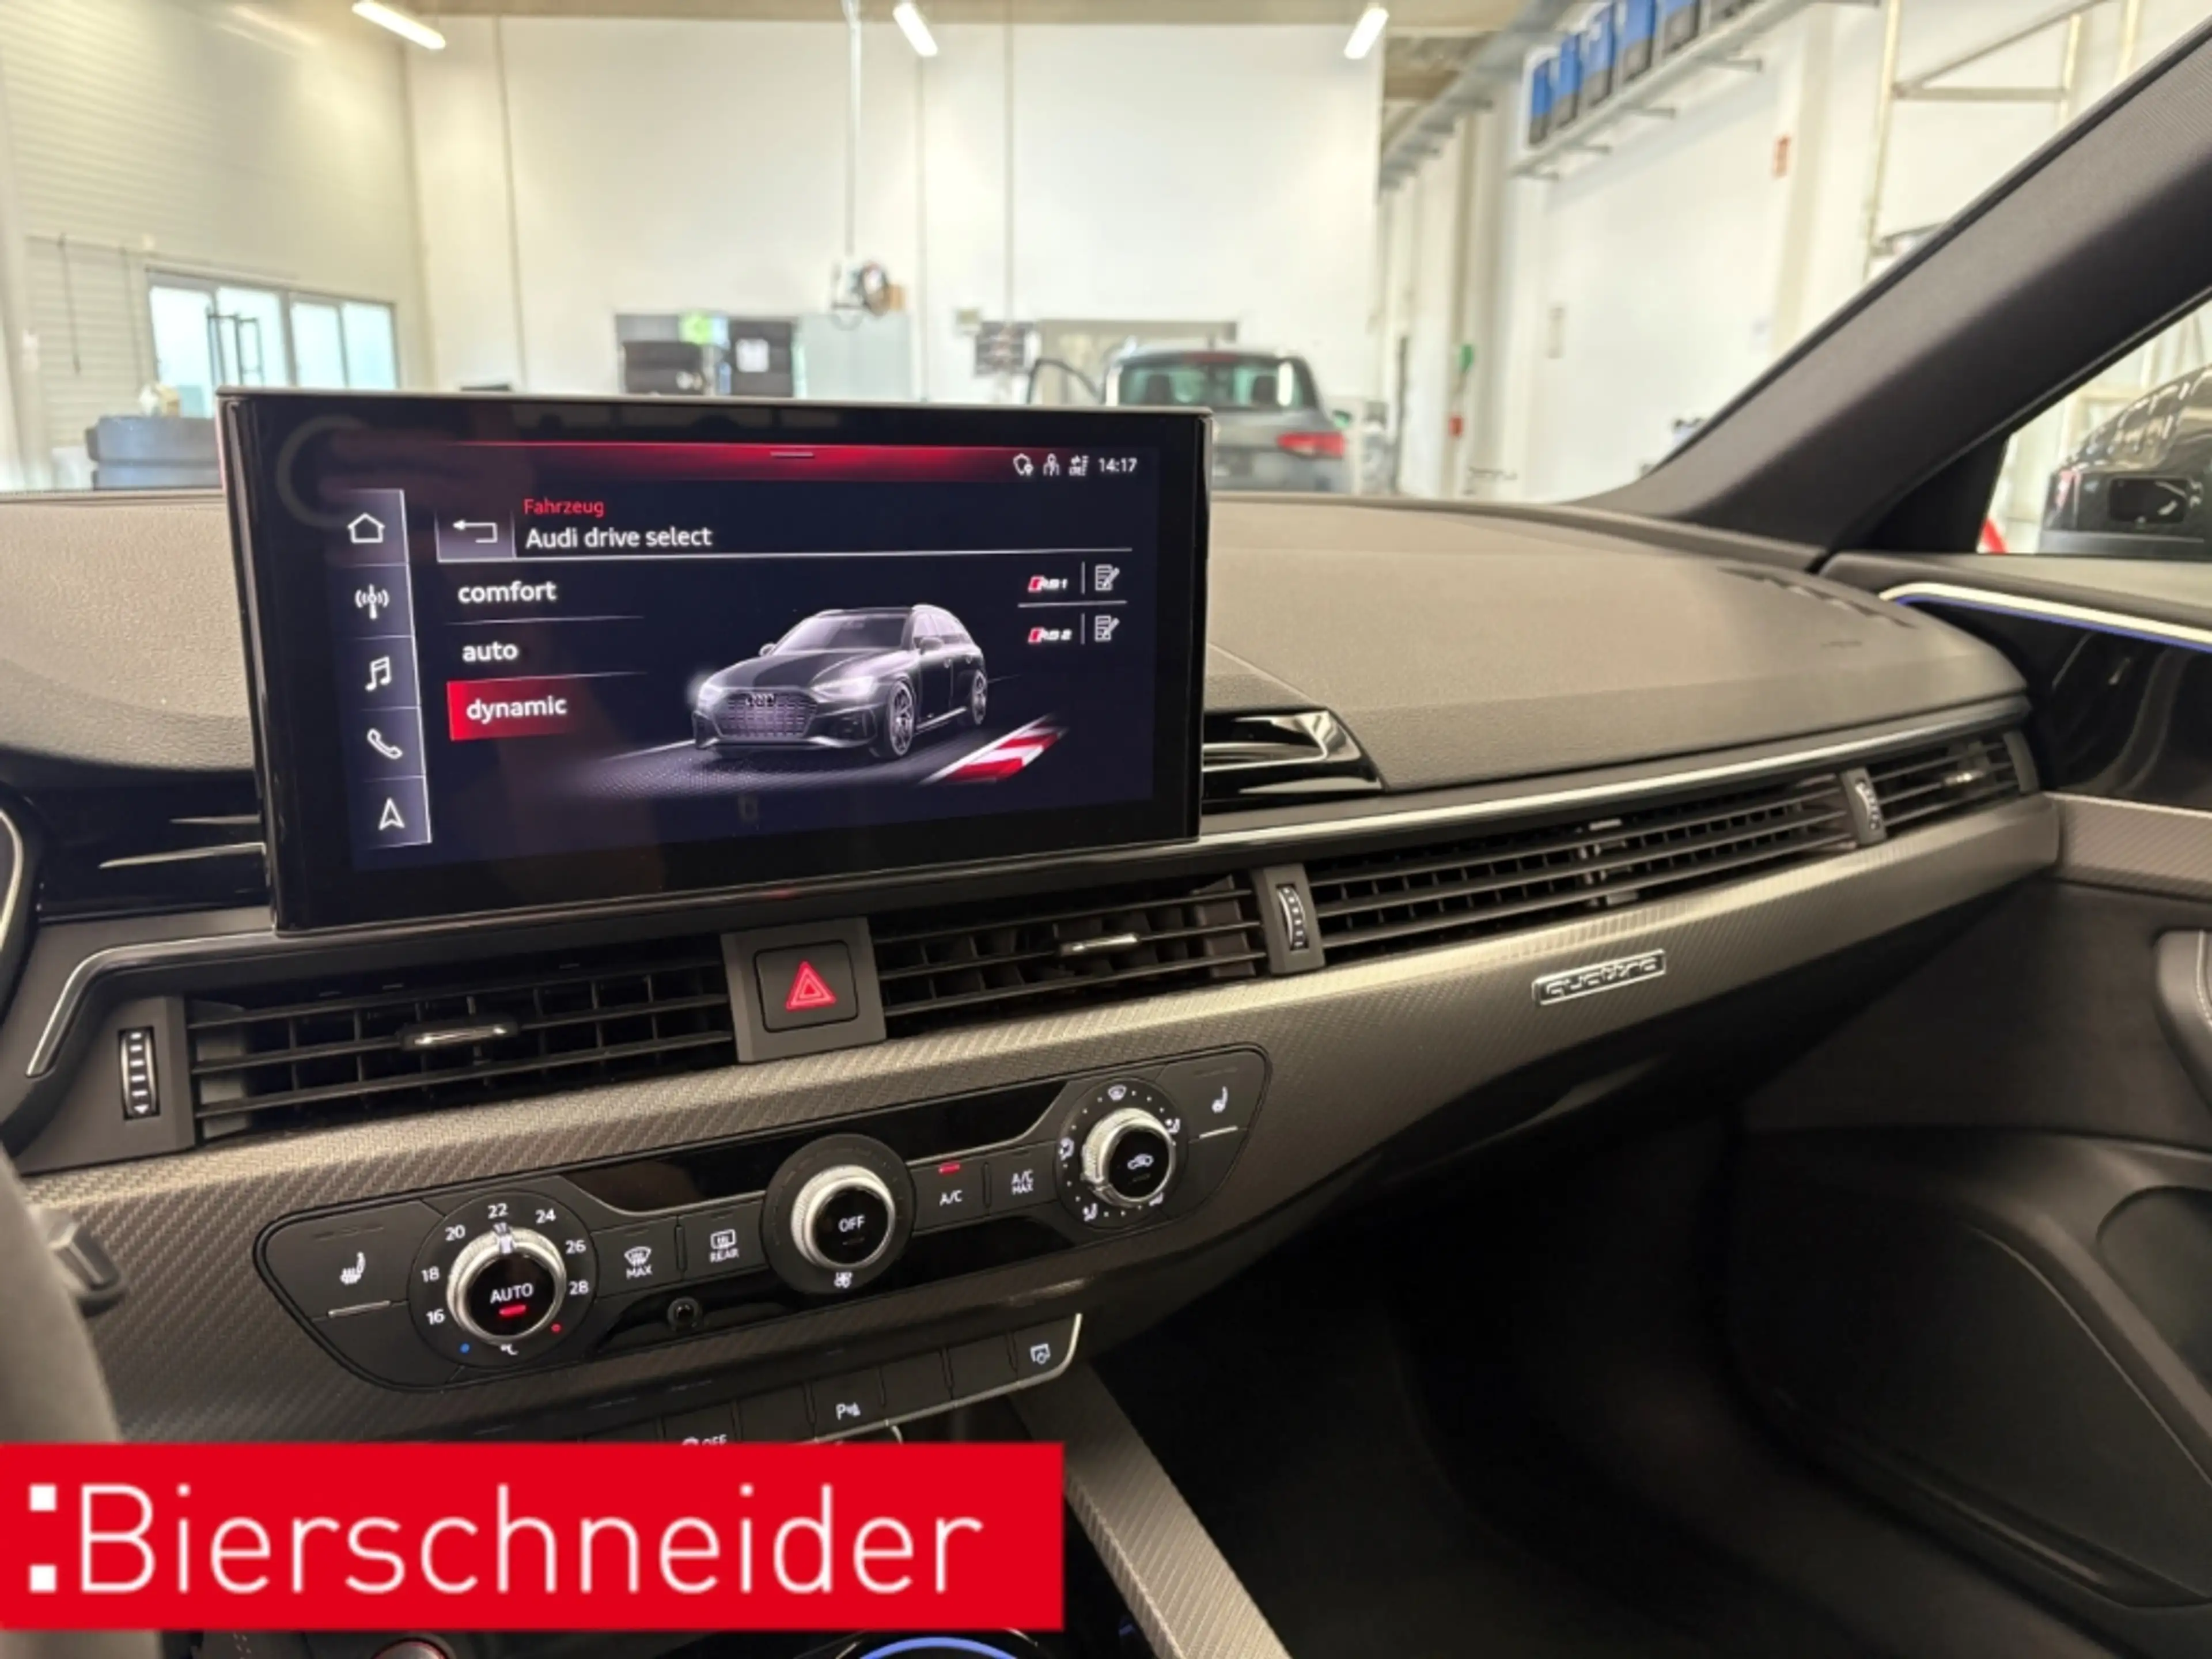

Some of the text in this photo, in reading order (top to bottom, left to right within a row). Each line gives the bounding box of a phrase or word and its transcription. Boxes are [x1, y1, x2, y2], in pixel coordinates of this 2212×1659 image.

[1099, 457, 1137, 472] 14:17
[522, 498, 606, 518] Fahrzeug
[525, 526, 713, 549] Audi drive select
[457, 580, 557, 604] comfort
[461, 641, 519, 662] auto
[466, 695, 567, 724] dynamic
[1011, 1169, 1033, 1185] A/C
[1012, 1183, 1033, 1195] MAX
[940, 1190, 963, 1206] A/C
[487, 1202, 508, 1218] 22
[535, 1209, 556, 1224] 24
[838, 1215, 865, 1232] OFF
[445, 1225, 466, 1241] 20
[566, 1239, 587, 1255] 26
[709, 1248, 739, 1263] REAR
[421, 1266, 440, 1283] 18
[626, 1264, 653, 1280] MAX
[490, 1282, 534, 1304] AUTO
[569, 1280, 589, 1296] 28
[426, 1309, 445, 1325] 16
